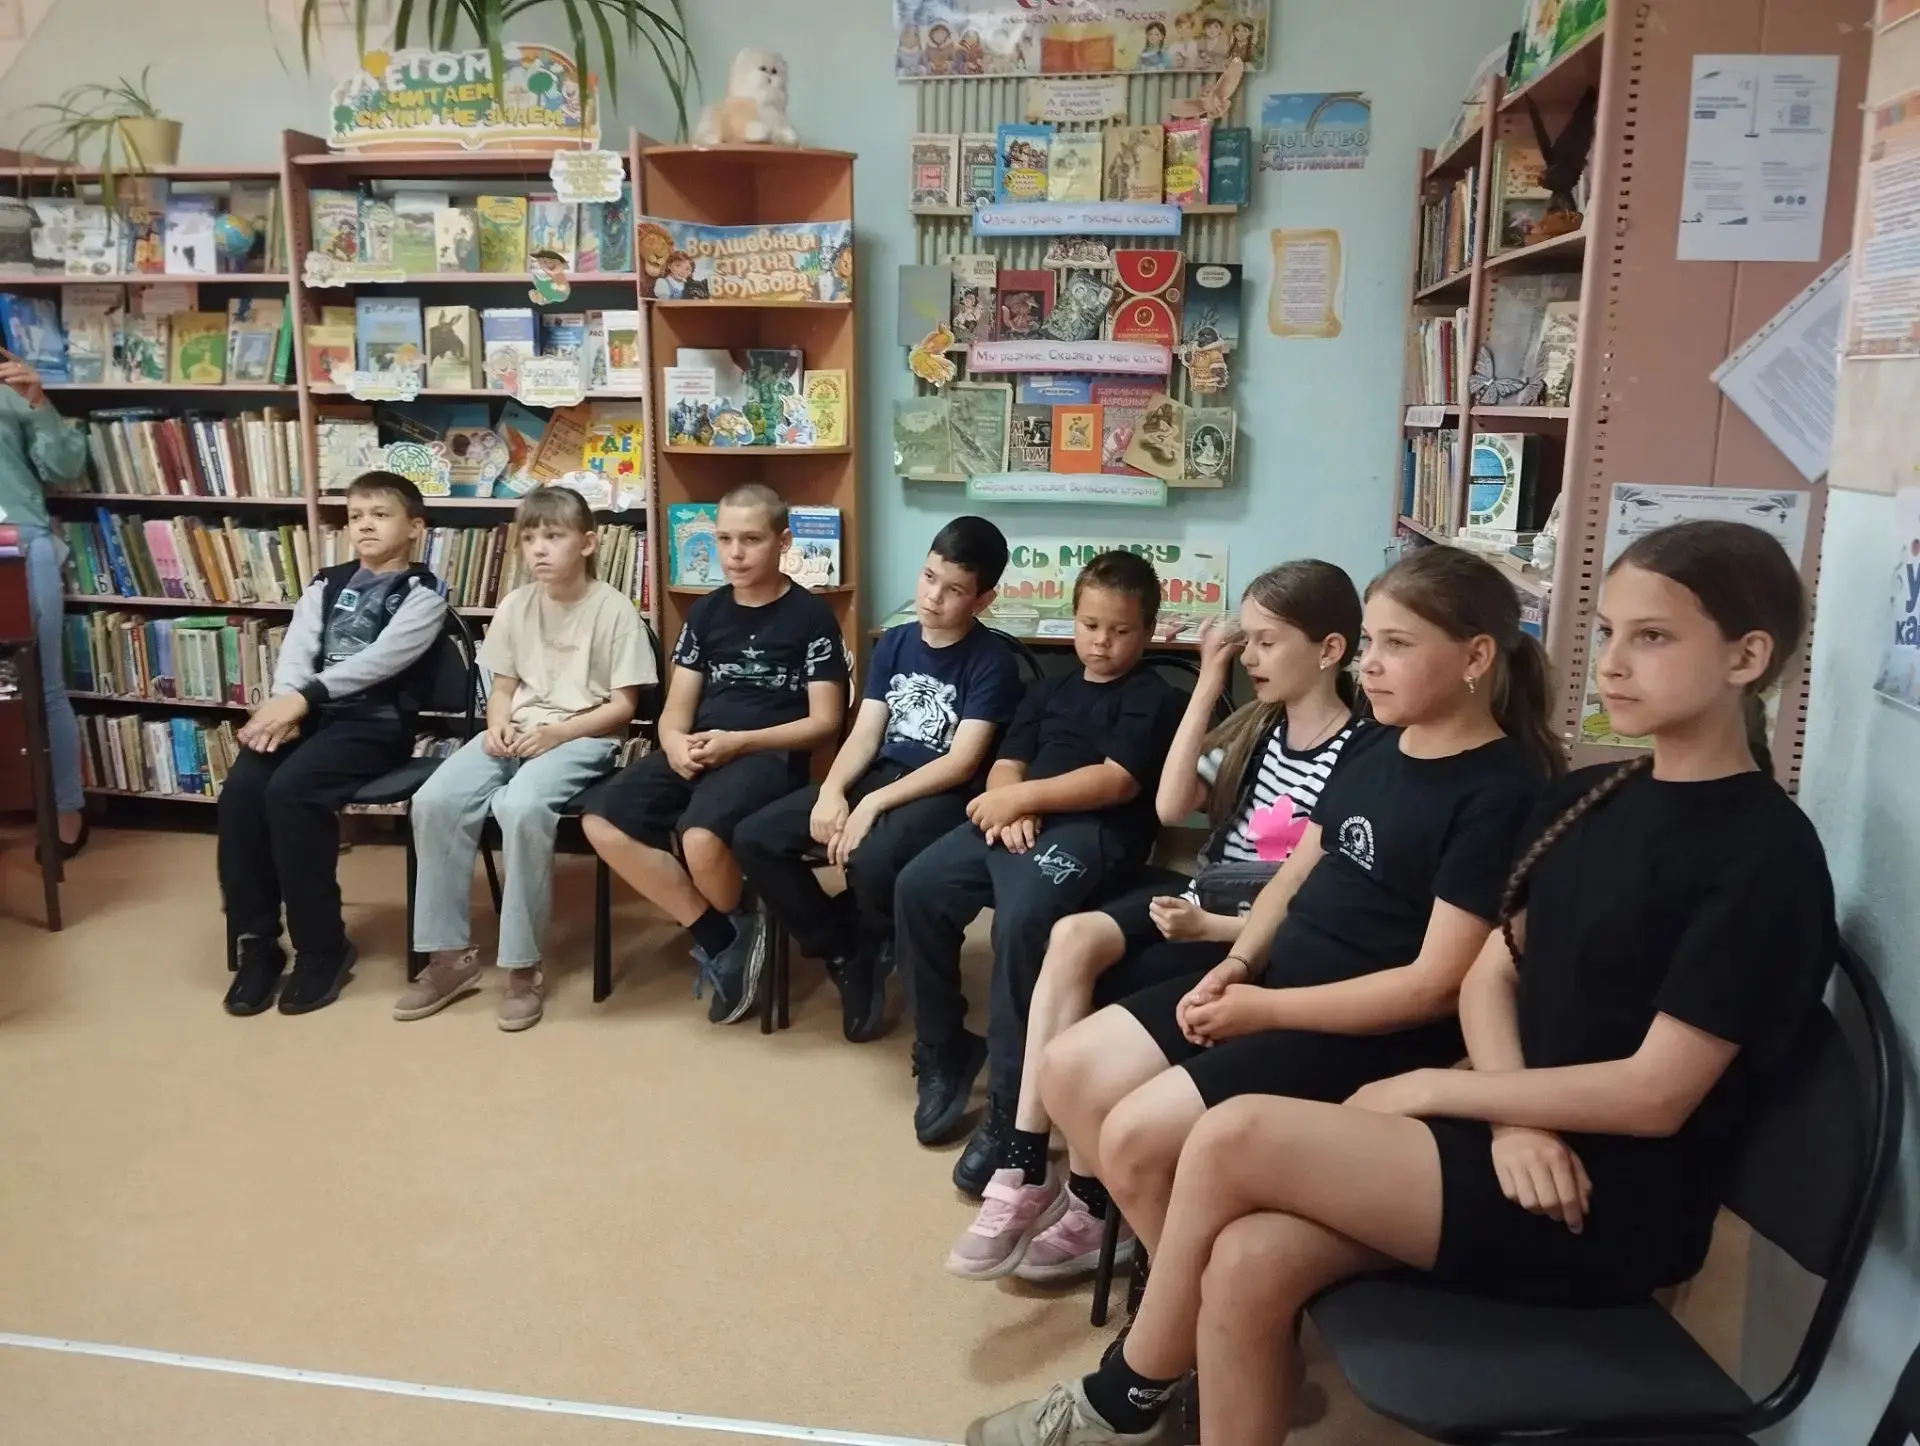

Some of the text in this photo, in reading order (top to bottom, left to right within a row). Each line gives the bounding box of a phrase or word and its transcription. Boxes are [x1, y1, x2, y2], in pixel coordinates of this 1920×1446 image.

[350, 55, 493, 97] ЛЕТОМ
[388, 83, 496, 109] ЧИТАЕМ
[484, 105, 564, 127] ЗНАЕМ
[976, 352, 995, 361] Мы
[1050, 350, 1093, 361] Сказка
[1109, 354, 1129, 363] нас
[1134, 355, 1163, 364] одна
